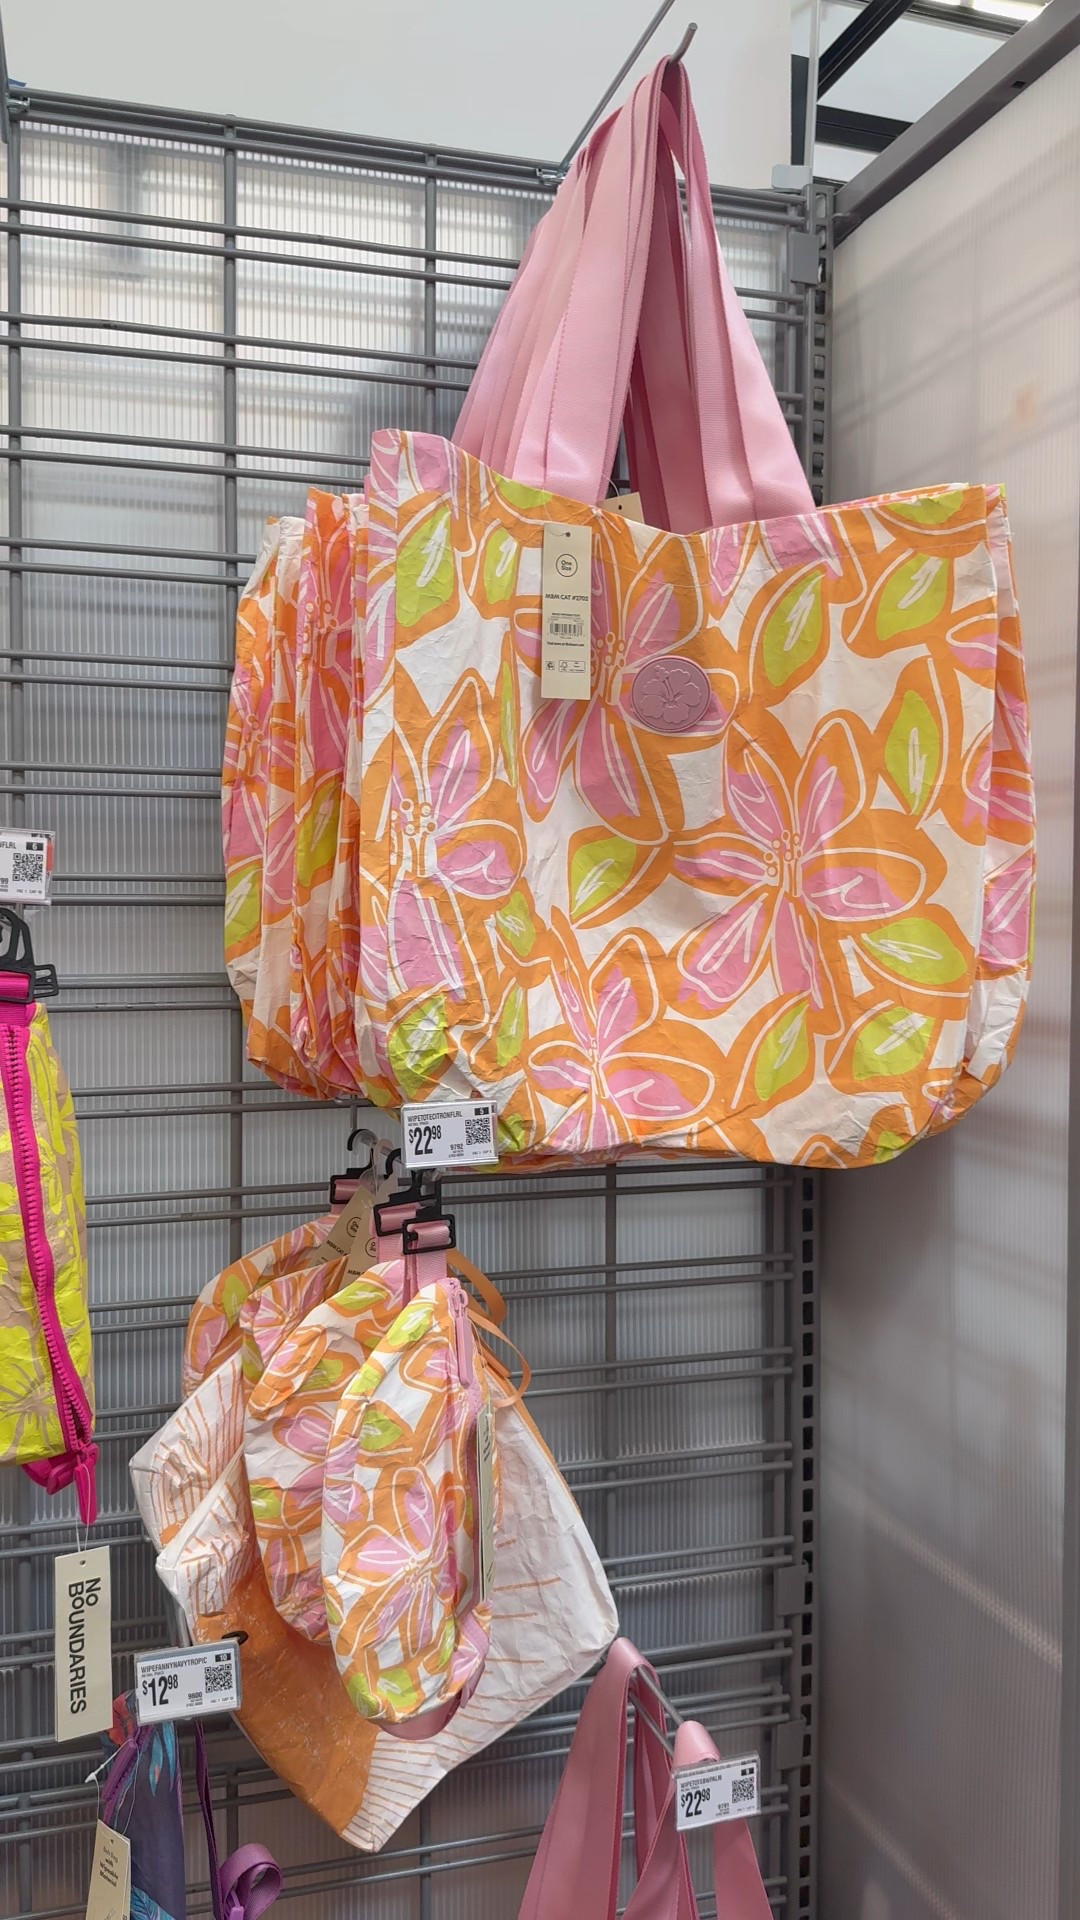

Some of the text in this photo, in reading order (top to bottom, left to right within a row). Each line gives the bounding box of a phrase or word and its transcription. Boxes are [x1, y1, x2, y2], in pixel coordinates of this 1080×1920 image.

[85, 1577, 101, 1607] NO
[68, 1581, 87, 1714] BOUNDARIES
[141, 1656, 208, 1673] WIPEFANNYNAVYTROPIC
